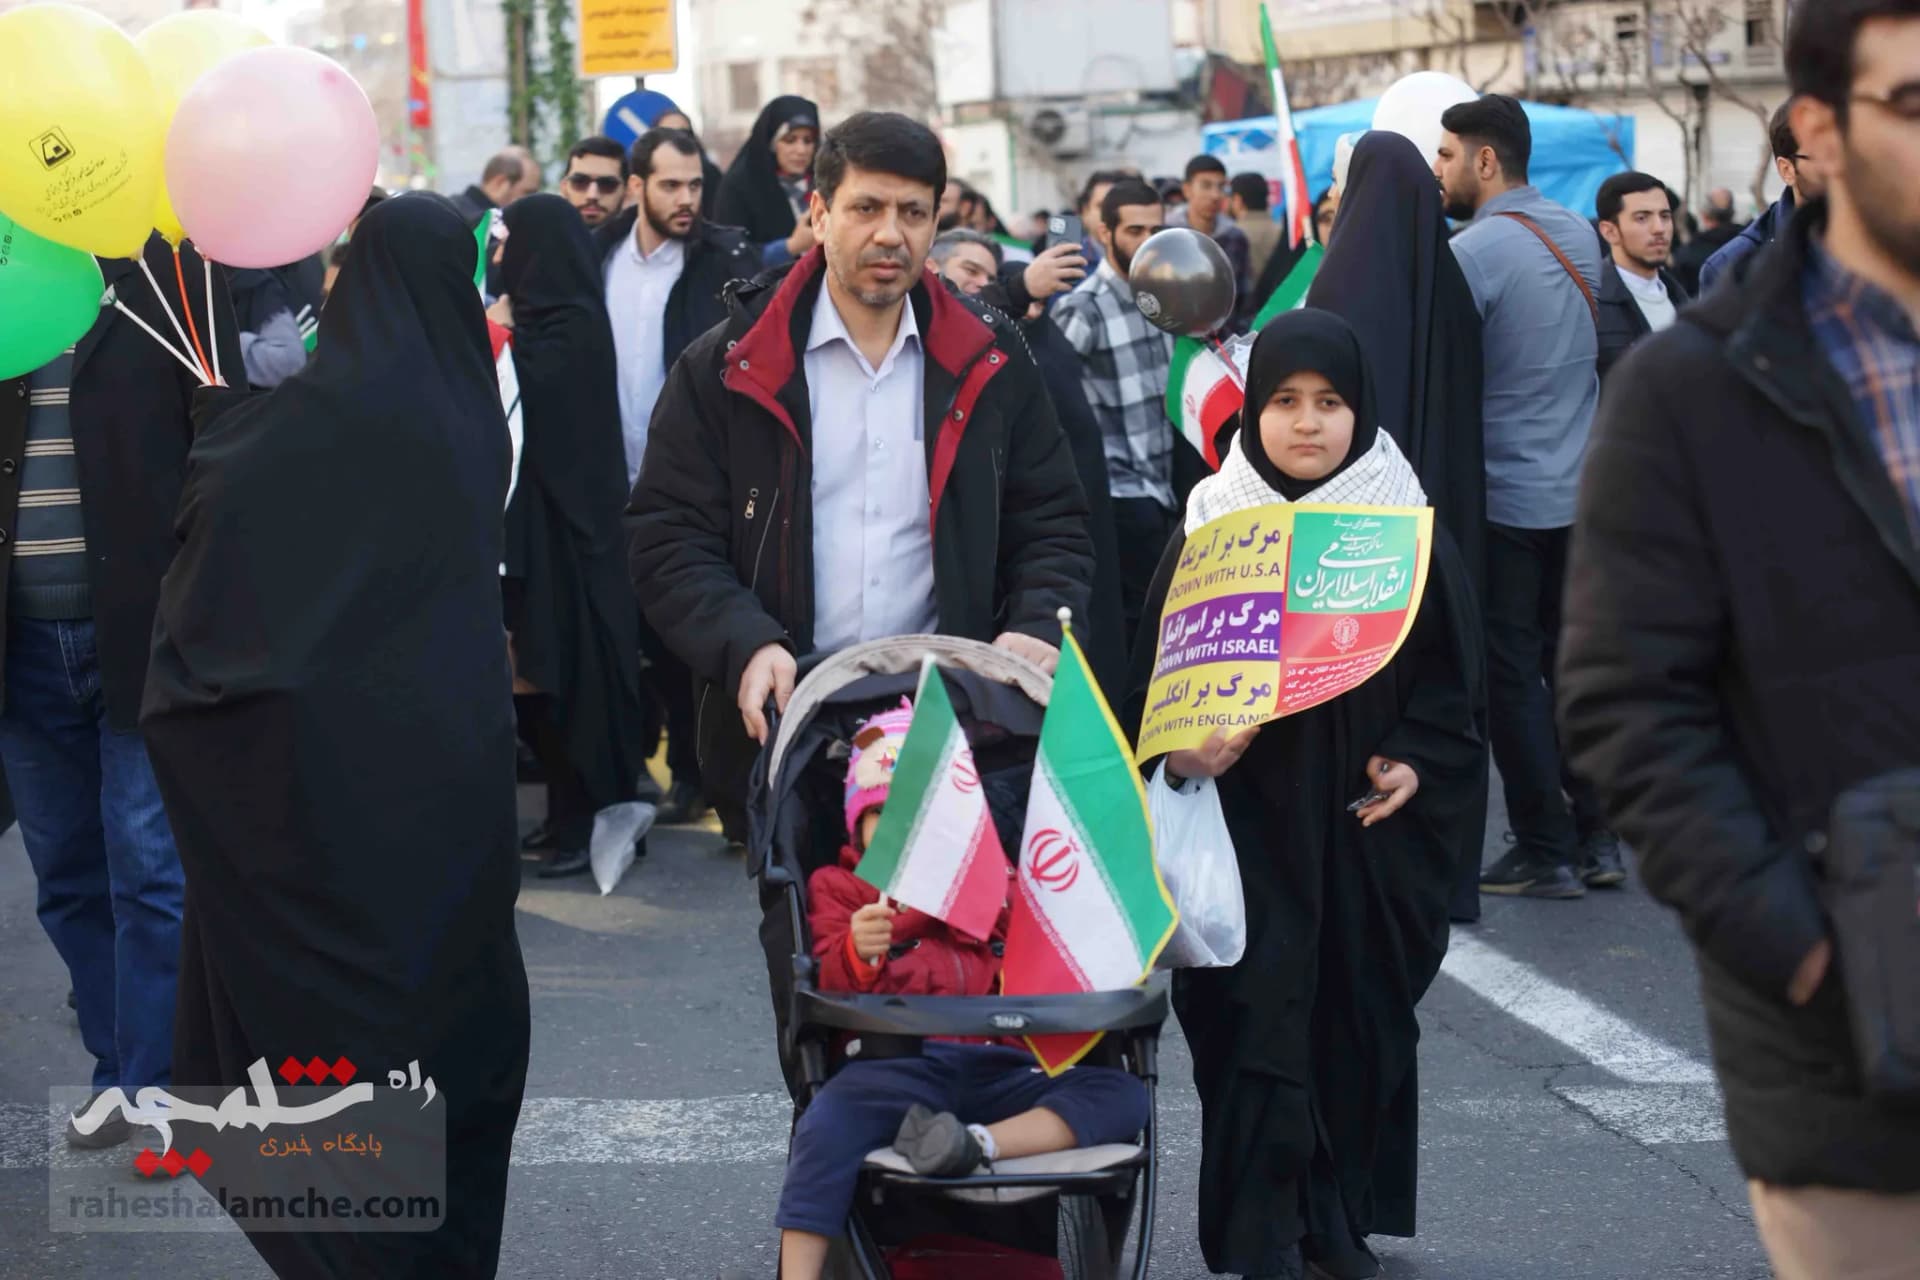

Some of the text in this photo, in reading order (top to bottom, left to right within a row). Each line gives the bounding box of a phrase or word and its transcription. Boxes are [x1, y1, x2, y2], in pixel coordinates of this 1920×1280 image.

[1218, 534, 1235, 561] بر
[1238, 522, 1280, 554] مرگ
[1204, 566, 1237, 587] WITH
[1240, 562, 1280, 578] U.S.A
[1295, 567, 1341, 609] ایران
[1327, 566, 1407, 609] انقلاب
[1206, 609, 1225, 638] بر
[1229, 599, 1280, 633] مرگ
[1185, 642, 1218, 661] WITH
[1221, 638, 1279, 655] ISRAEL
[1191, 682, 1210, 708] بر
[1216, 672, 1271, 706] مرگ
[1164, 716, 1193, 733] WITH
